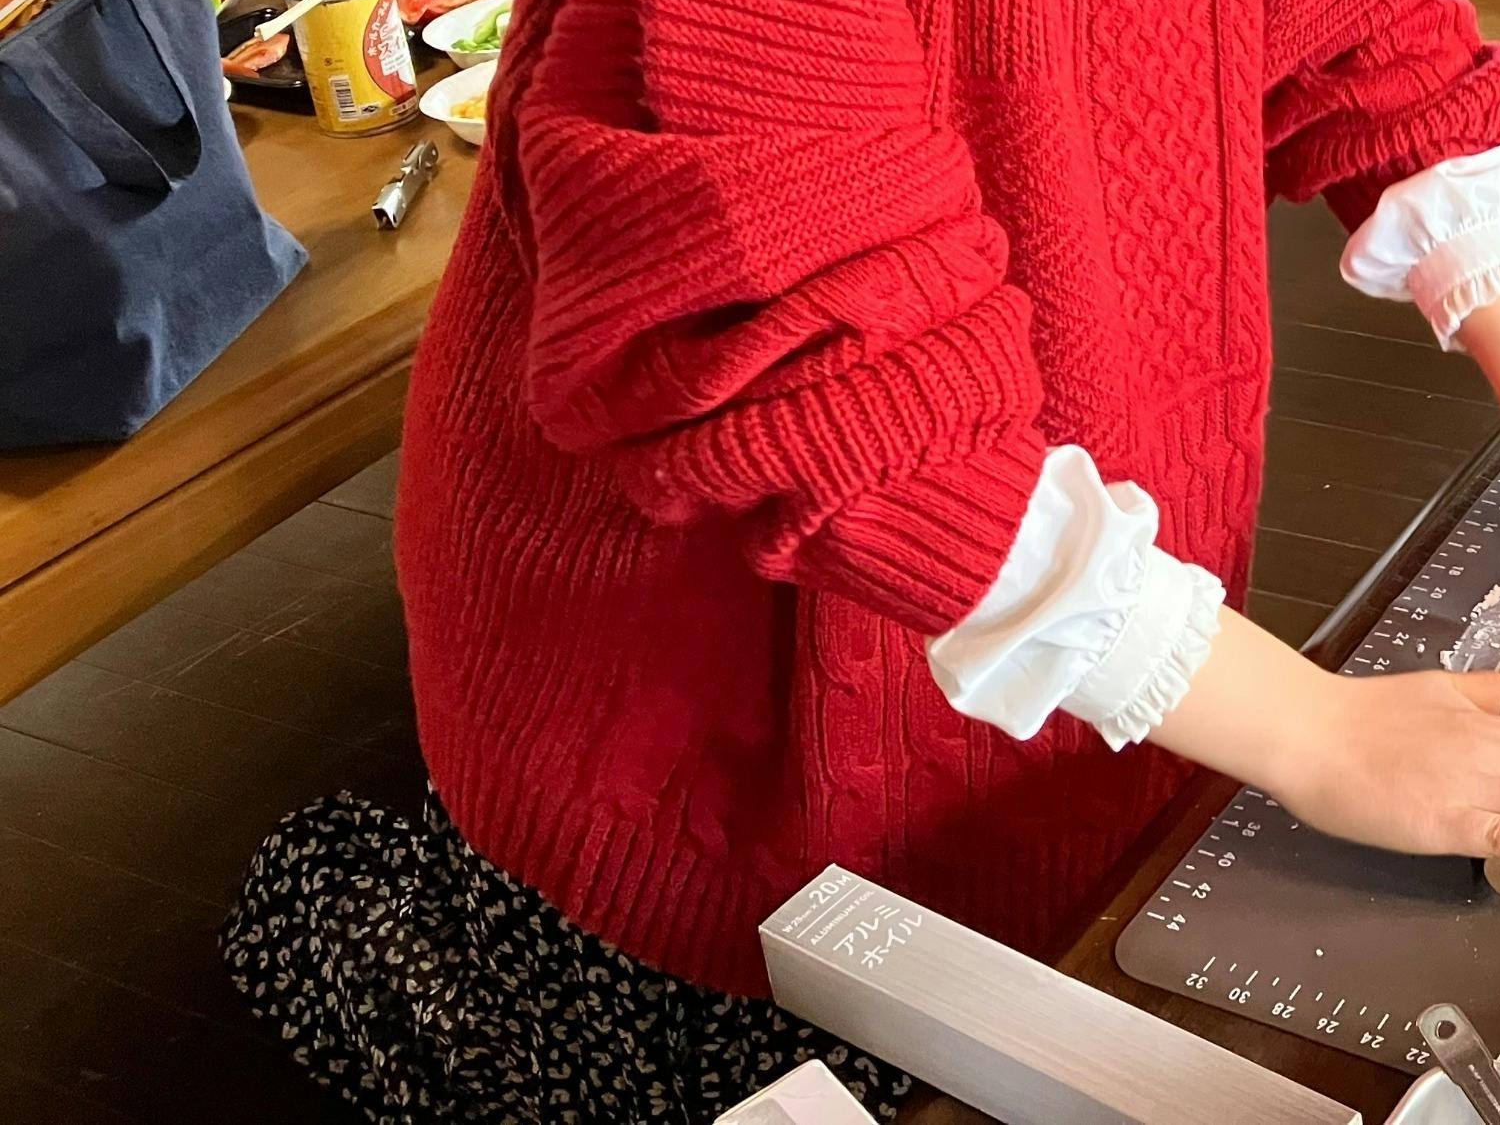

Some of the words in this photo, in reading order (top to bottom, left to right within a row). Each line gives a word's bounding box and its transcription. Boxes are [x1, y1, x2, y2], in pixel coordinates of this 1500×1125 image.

[1483, 522, 1498, 533] 14
[1448, 565, 1464, 576] 18
[1430, 587, 1447, 599] 20
[1411, 607, 1428, 621] 22
[1392, 631, 1410, 646] 24
[1373, 656, 1390, 671] 26
[1217, 851, 1236, 868] 40
[1192, 882, 1212, 899] 42
[832, 904, 901, 955] アルミ
[1166, 913, 1186, 931] 44
[860, 914, 922, 969] ホイル
[1186, 973, 1208, 989] 32
[1228, 987, 1251, 1004] 30
[1271, 1002, 1296, 1019] 28
[1316, 1017, 1340, 1034] 26
[1359, 1031, 1385, 1049] 24
[1405, 1047, 1431, 1065] 22
